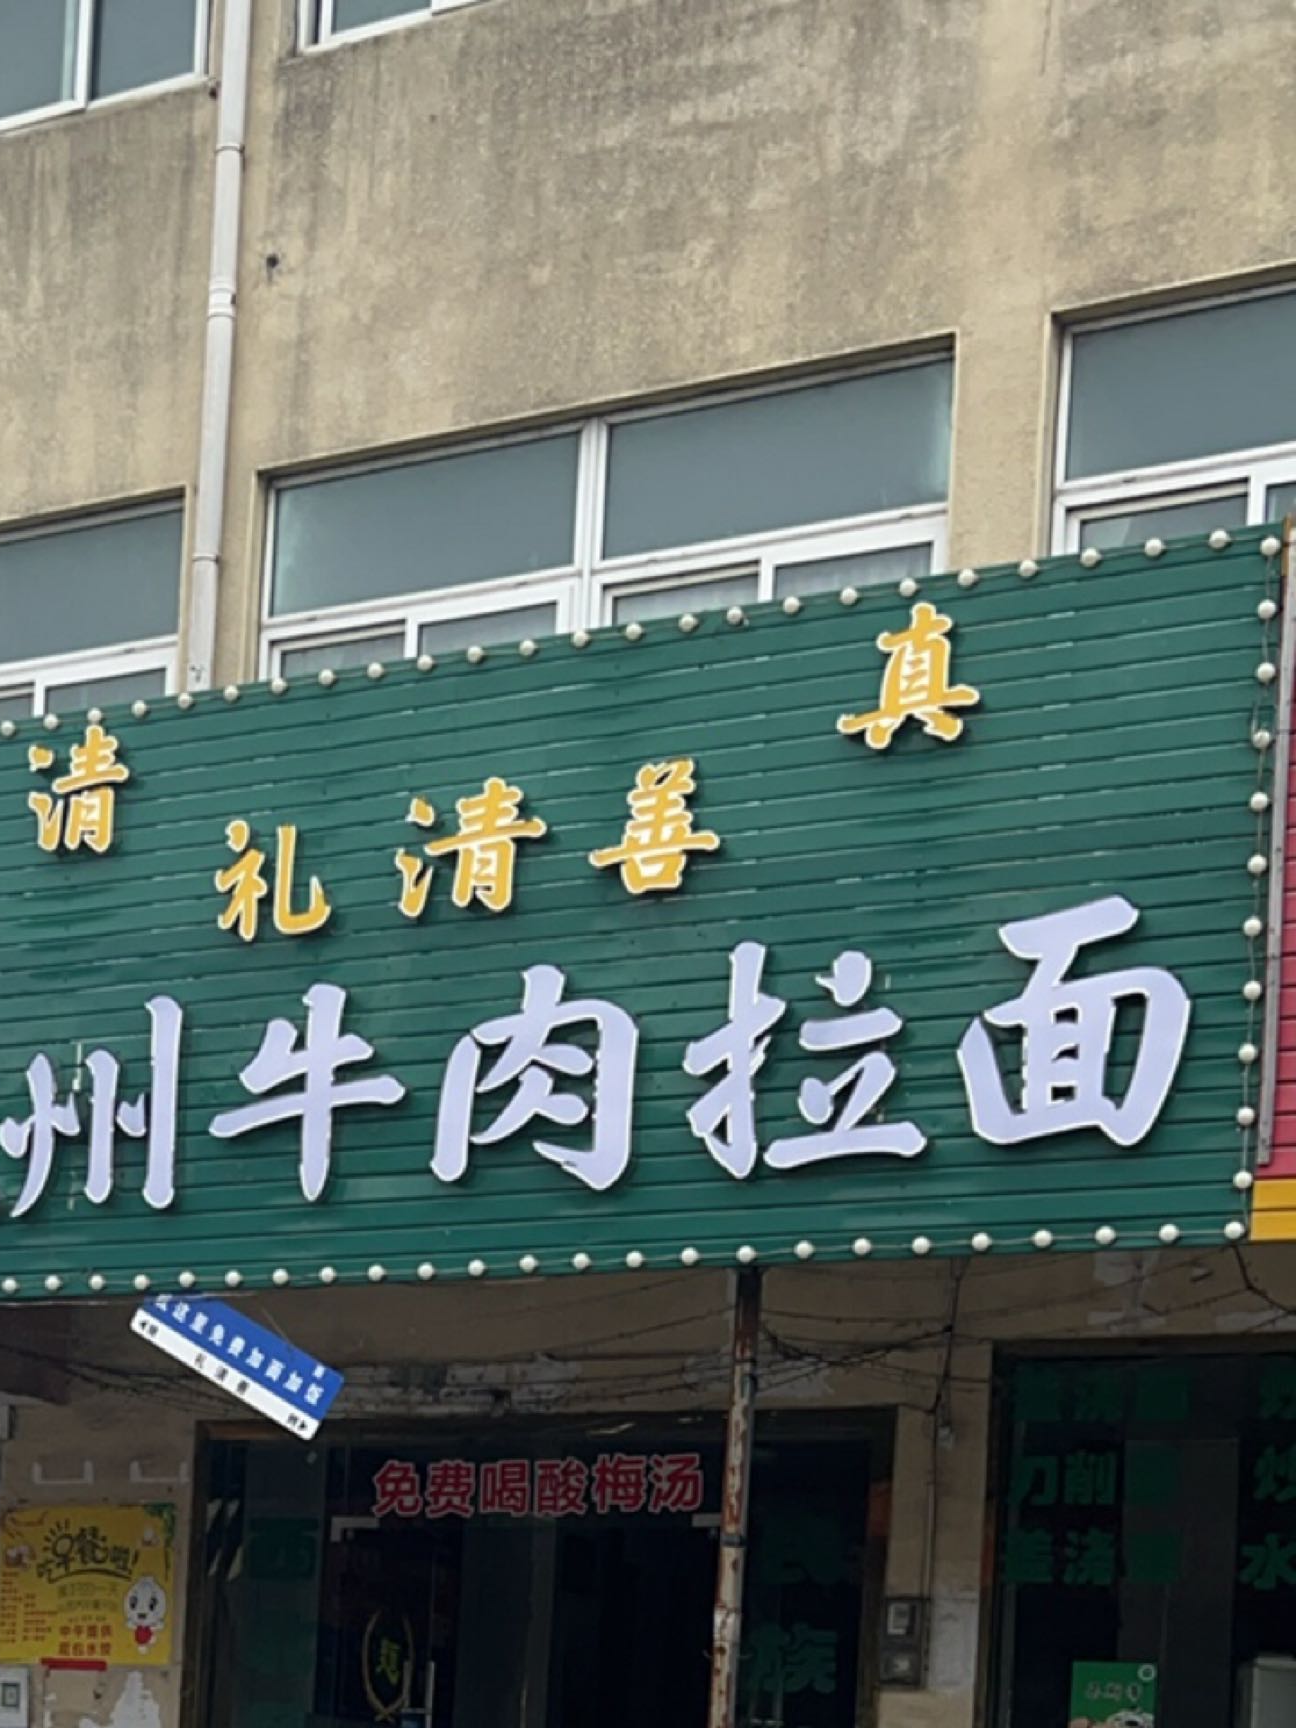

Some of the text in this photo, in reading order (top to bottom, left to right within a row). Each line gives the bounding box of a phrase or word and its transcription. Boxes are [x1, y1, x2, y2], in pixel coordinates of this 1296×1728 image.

[371, 1453, 702, 1518] 免费喝酸梅汤
